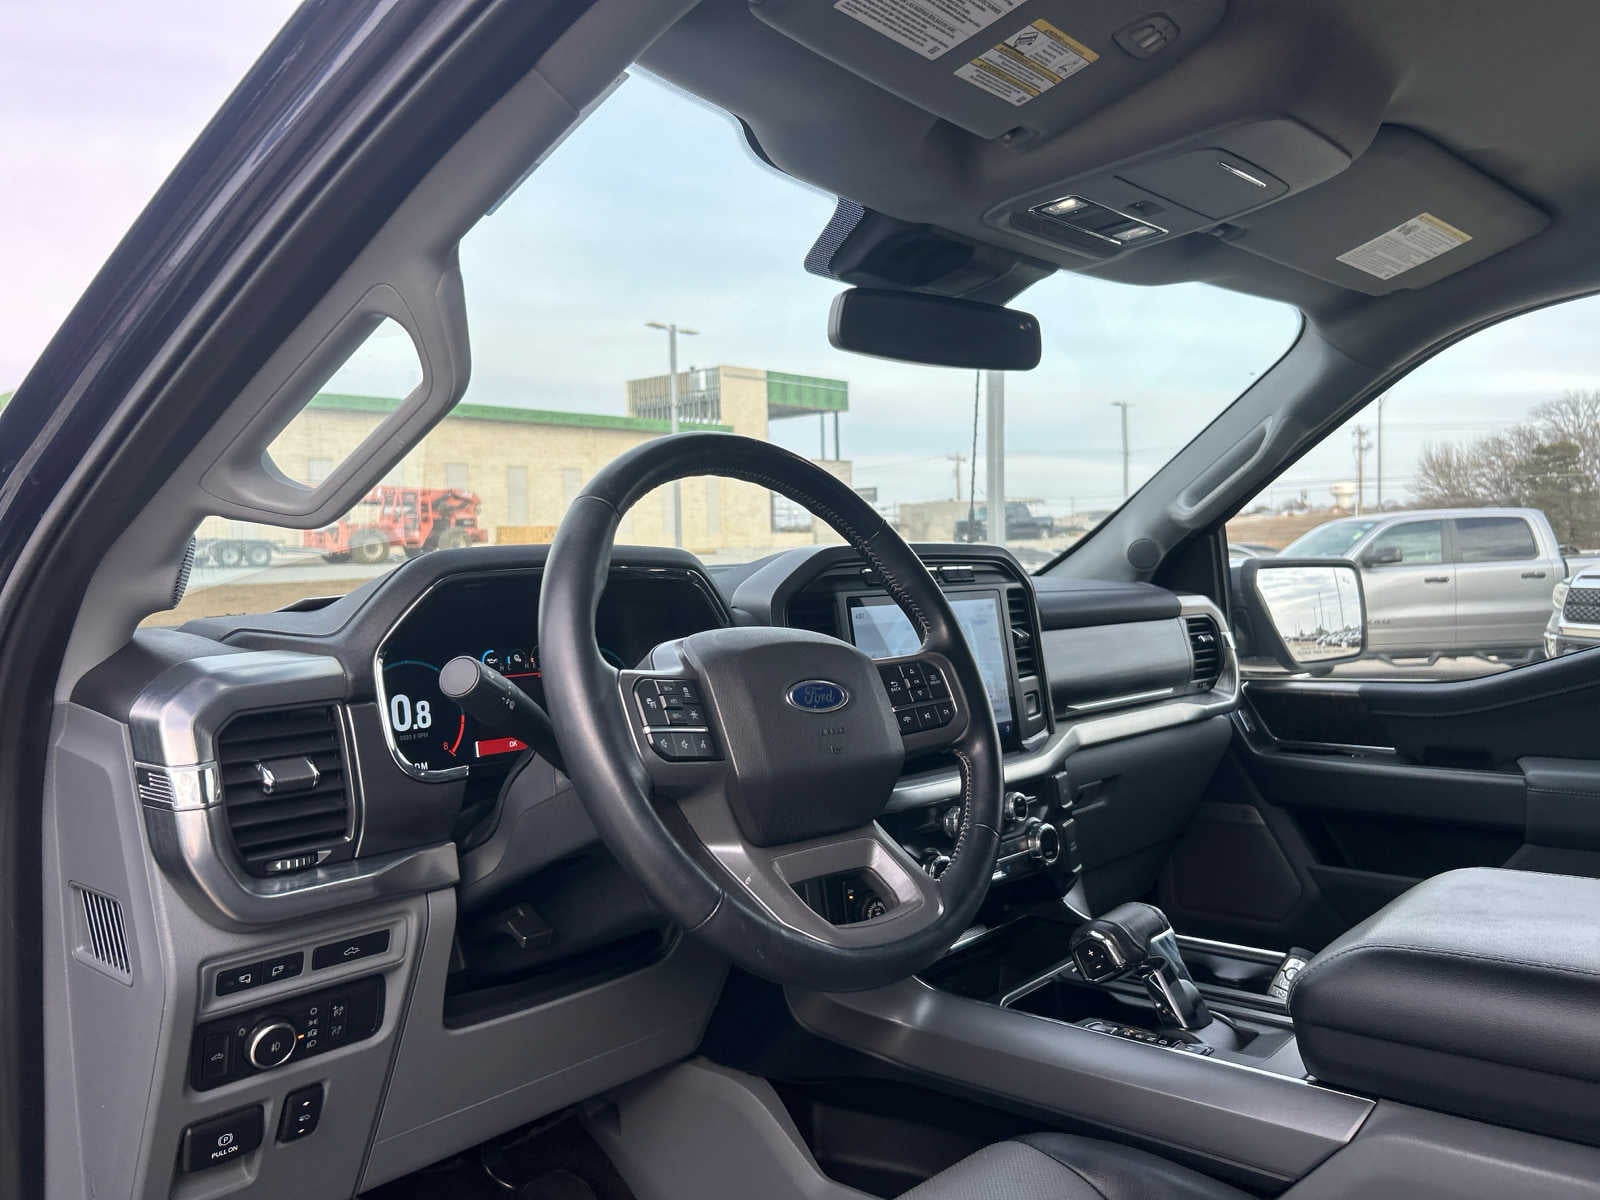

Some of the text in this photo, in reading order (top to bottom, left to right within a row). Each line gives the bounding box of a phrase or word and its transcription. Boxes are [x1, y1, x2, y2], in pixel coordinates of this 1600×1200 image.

[803, 686, 835, 705] Ford
[390, 694, 432, 731] 0.8
[442, 741, 449, 750] 8
[508, 740, 518, 748] OK
[211, 1145, 238, 1159] PULL ON
